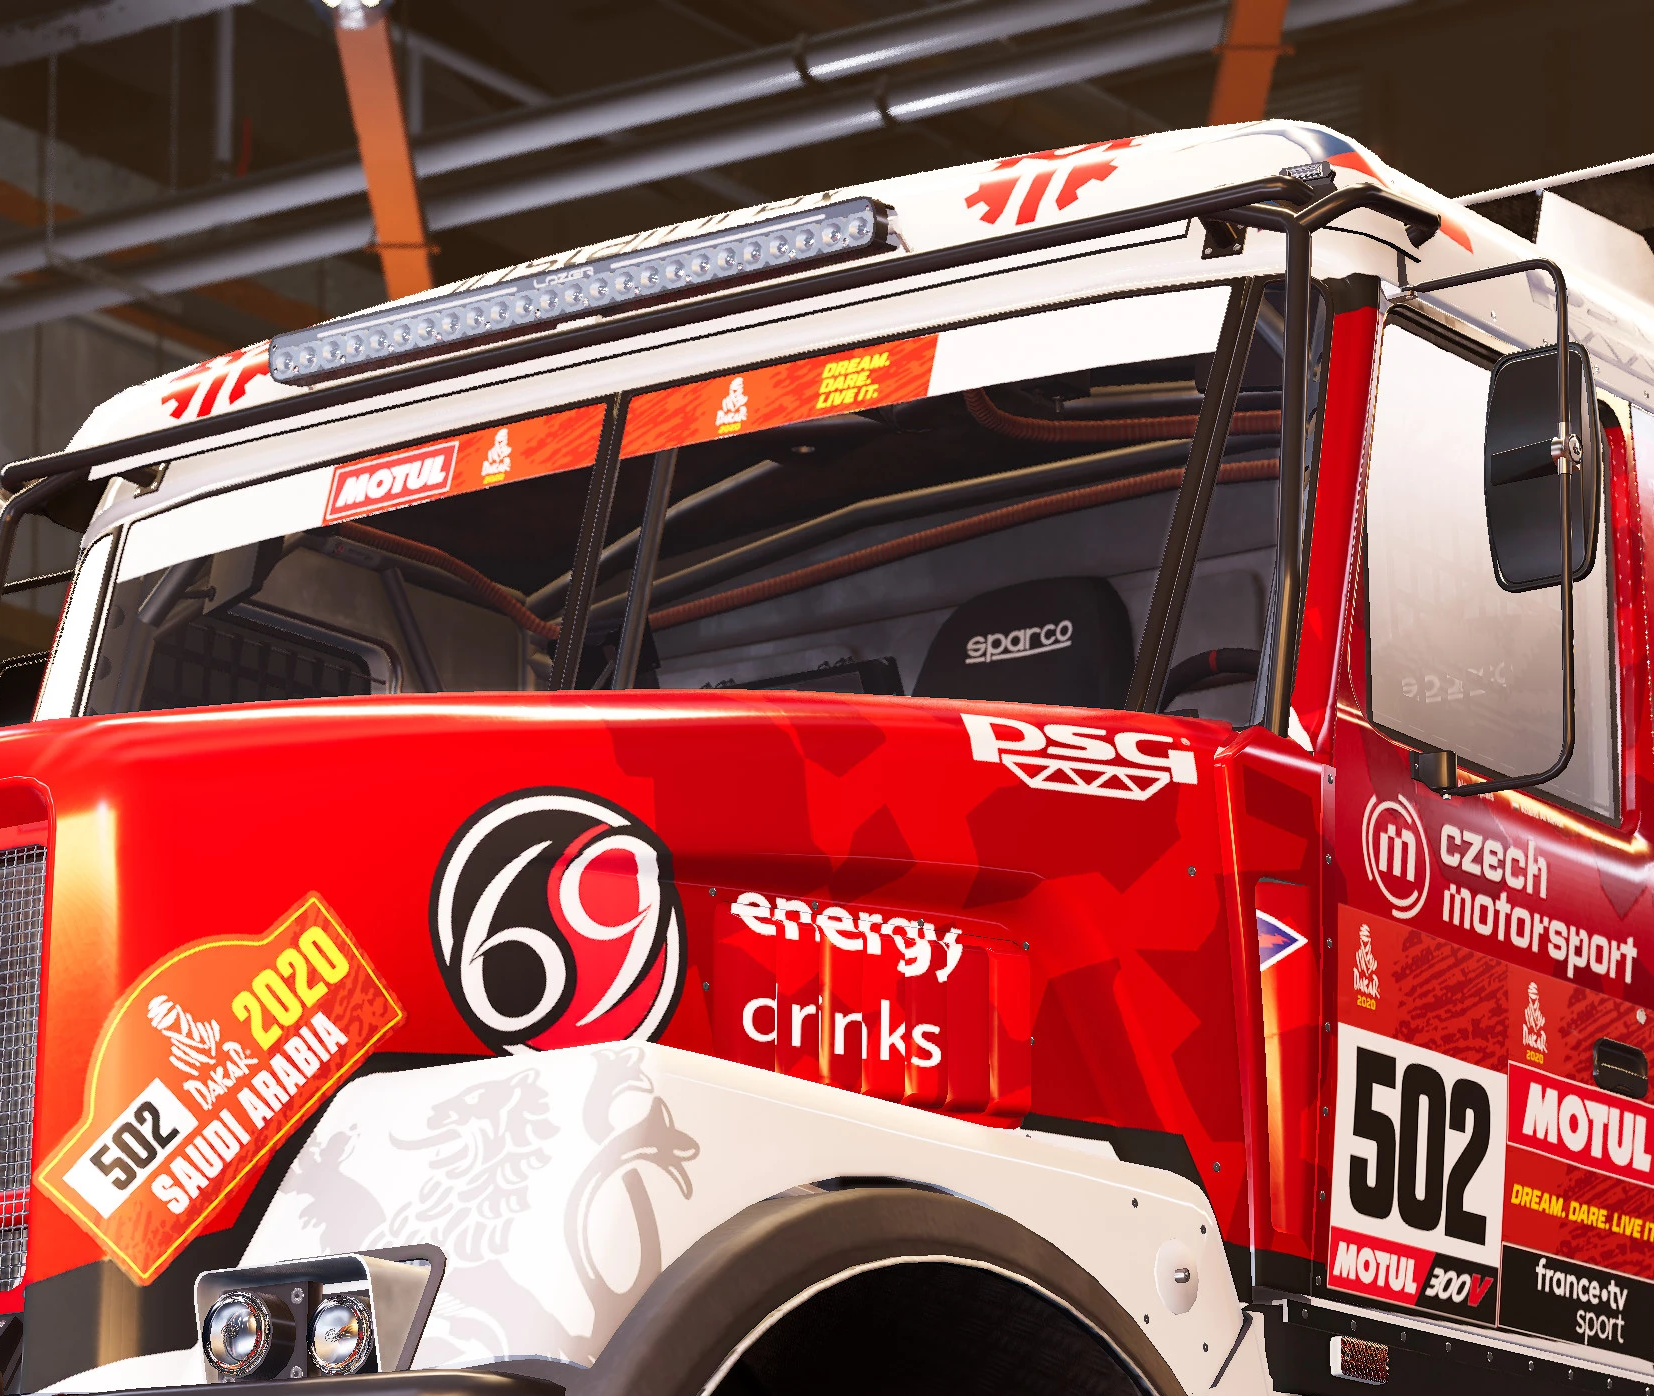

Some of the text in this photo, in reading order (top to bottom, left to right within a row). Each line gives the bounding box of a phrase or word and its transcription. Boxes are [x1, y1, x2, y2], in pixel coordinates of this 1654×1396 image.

[816, 384, 879, 409] LIVE IT.
[820, 370, 871, 393] DARE.
[821, 352, 890, 377] DREAM.
[335, 454, 446, 508] MOTUL
[966, 620, 1073, 663] sparco
[1440, 824, 1547, 899] czech
[460, 835, 660, 1032] 69
[730, 891, 963, 982] energy
[1442, 884, 1637, 984] motorsport
[232, 925, 350, 1051] 2020
[1357, 994, 1376, 1011] 2020
[743, 983, 942, 1068] drinks
[1526, 1050, 1544, 1064] 2020
[89, 1100, 180, 1191] 502
[151, 1011, 349, 1215] SAUDI ARABIA
[1349, 1045, 1491, 1246] 502
[1522, 1081, 1652, 1173] MOTUL
[1511, 1184, 1565, 1218] DREAM.
[1568, 1200, 1610, 1229] DARE.
[1612, 1213, 1643, 1240] LIVE
[1333, 1241, 1493, 1307] MOTUL 300V
[1576, 1308, 1625, 1345] sport
